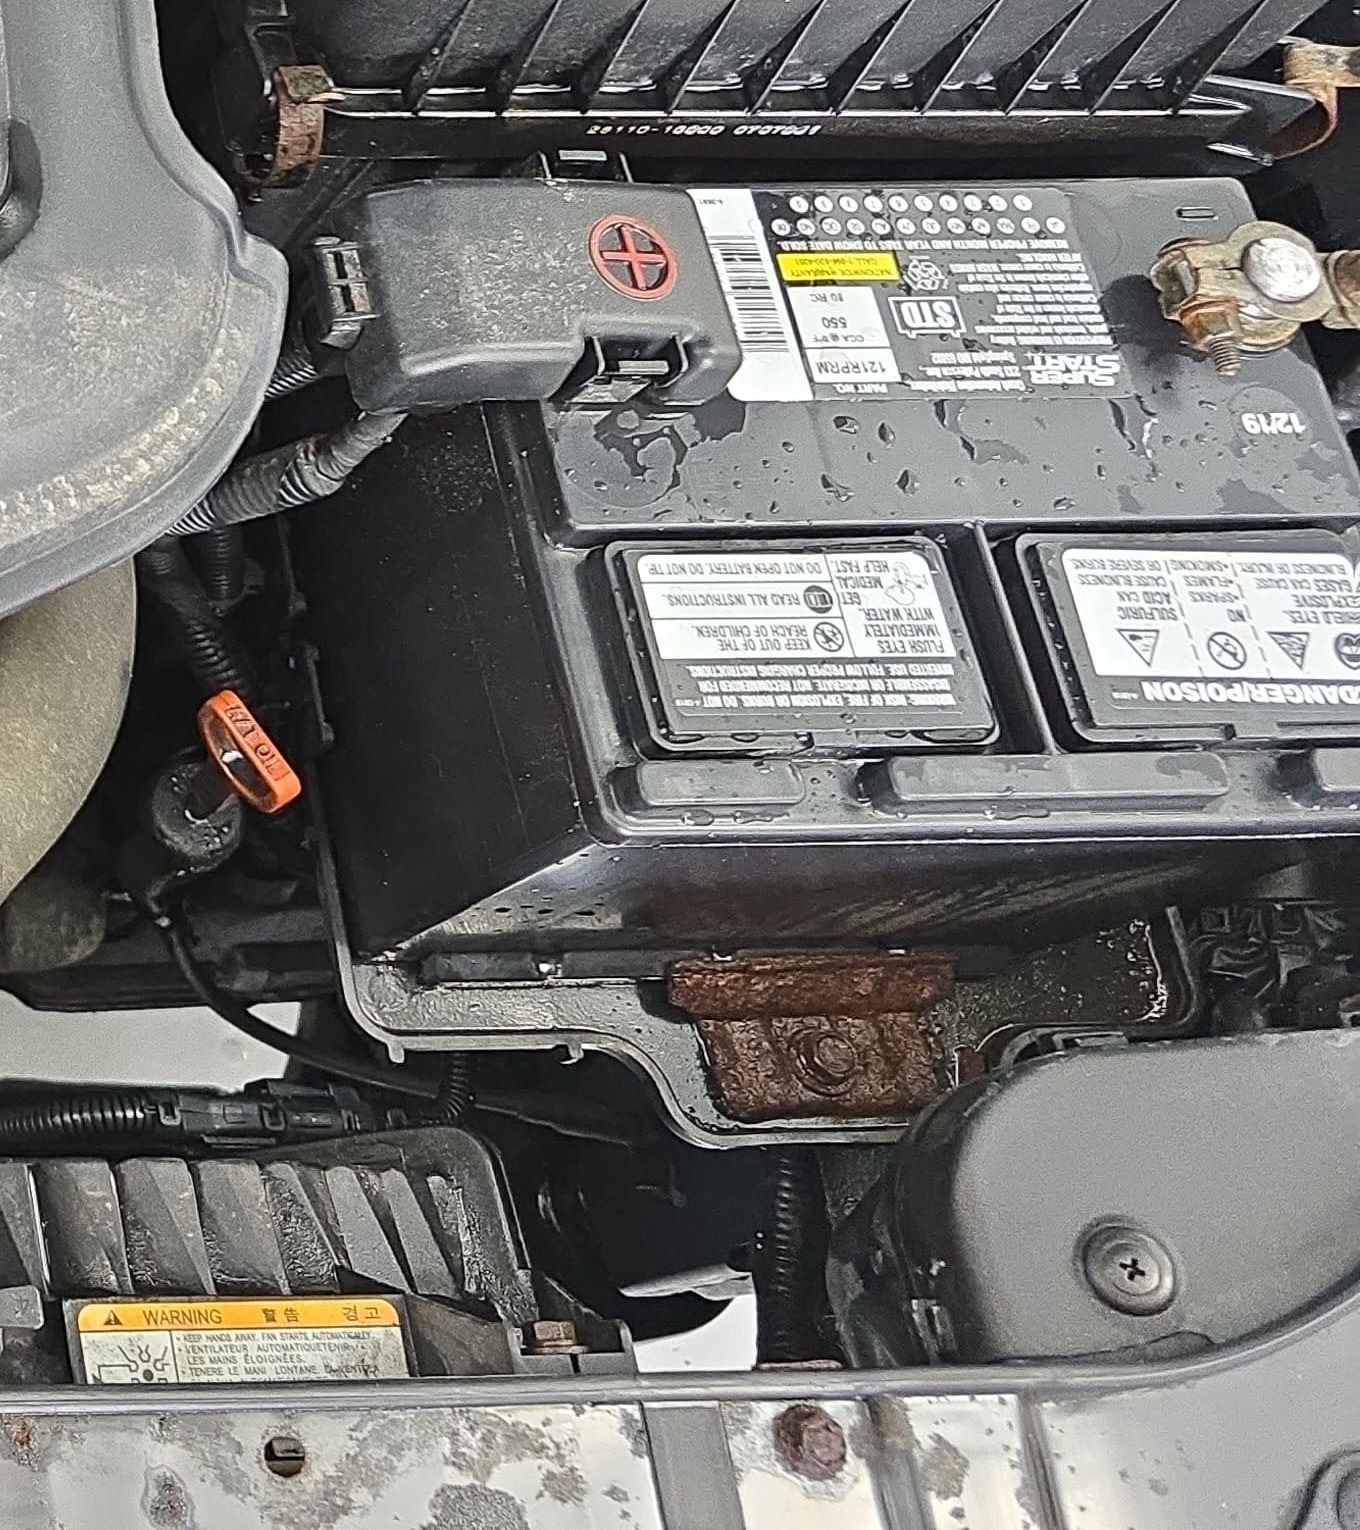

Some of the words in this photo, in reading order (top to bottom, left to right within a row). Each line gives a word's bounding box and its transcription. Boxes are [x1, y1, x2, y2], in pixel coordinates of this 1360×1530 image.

[899, 300, 955, 329] STD
[821, 317, 846, 328] 550
[815, 361, 885, 373] 121RPRM
[1025, 351, 1120, 376] START
[1030, 369, 1114, 385] SUPER
[857, 381, 887, 392] PART
[1241, 410, 1306, 434] 12/19
[667, 563, 686, 574] NOT
[689, 563, 703, 574] DO
[753, 563, 780, 573] OPEN
[784, 563, 803, 573] NOT
[807, 562, 821, 573] DO
[864, 560, 889, 572] HELP
[839, 576, 882, 588] MEDICAL
[749, 594, 767, 604] ALL
[771, 593, 800, 604] READ
[842, 592, 860, 604] GET
[1142, 591, 1170, 604] ACID
[859, 608, 902, 620] WATER.
[905, 608, 933, 620] WITH
[1118, 606, 1177, 620] SULFURIC
[1229, 609, 1245, 621] NO
[755, 625, 767, 636] OF
[771, 625, 807, 636] REACH
[865, 624, 938, 636] IMMEDIATELY
[719, 639, 739, 650] THE
[743, 638, 755, 650] OF
[759, 638, 780, 650] OUT
[784, 638, 810, 649] KEEP
[877, 640, 906, 652] EYES
[908, 640, 943, 652] FLUSH
[1141, 680, 1360, 704] DANGER/POISON
[143, 1309, 221, 1324] WARNING
[205, 1333, 231, 1342] HANDS
[184, 1344, 247, 1353] VENTILATEUR
[186, 1355, 205, 1365] LES
[208, 1354, 237, 1364] MAINS
[188, 1367, 223, 1376] TENERE
[275, 1365, 319, 1374] LONTANE
